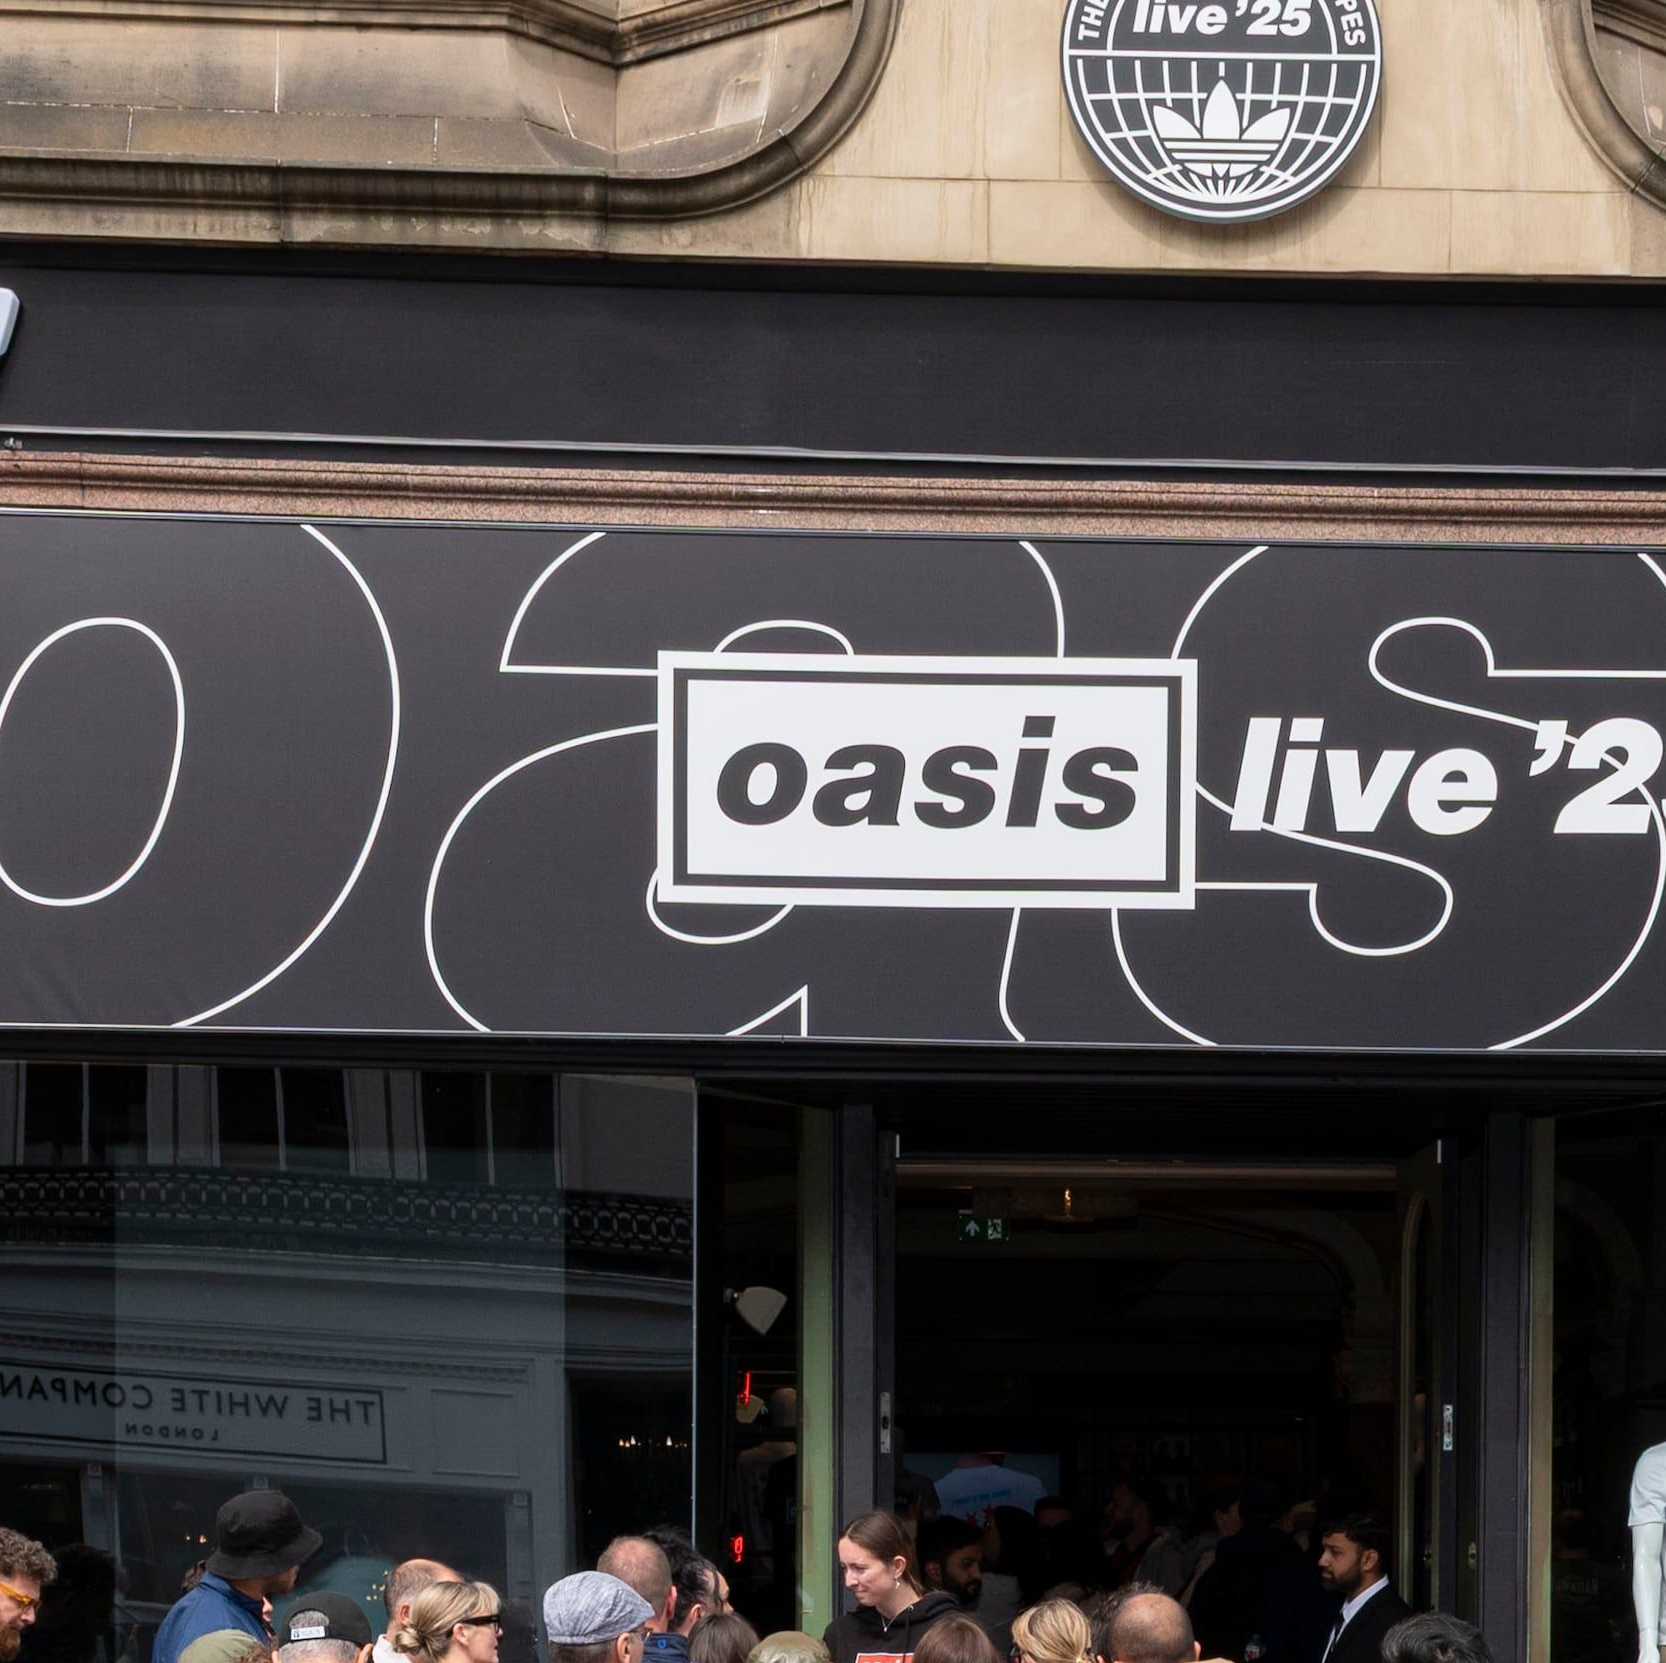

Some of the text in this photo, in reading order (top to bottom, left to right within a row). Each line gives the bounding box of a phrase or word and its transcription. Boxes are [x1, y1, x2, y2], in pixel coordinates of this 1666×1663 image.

[1132, 0, 1228, 35] live
[715, 715, 1138, 829] oasis
[1229, 716, 1498, 834] live
